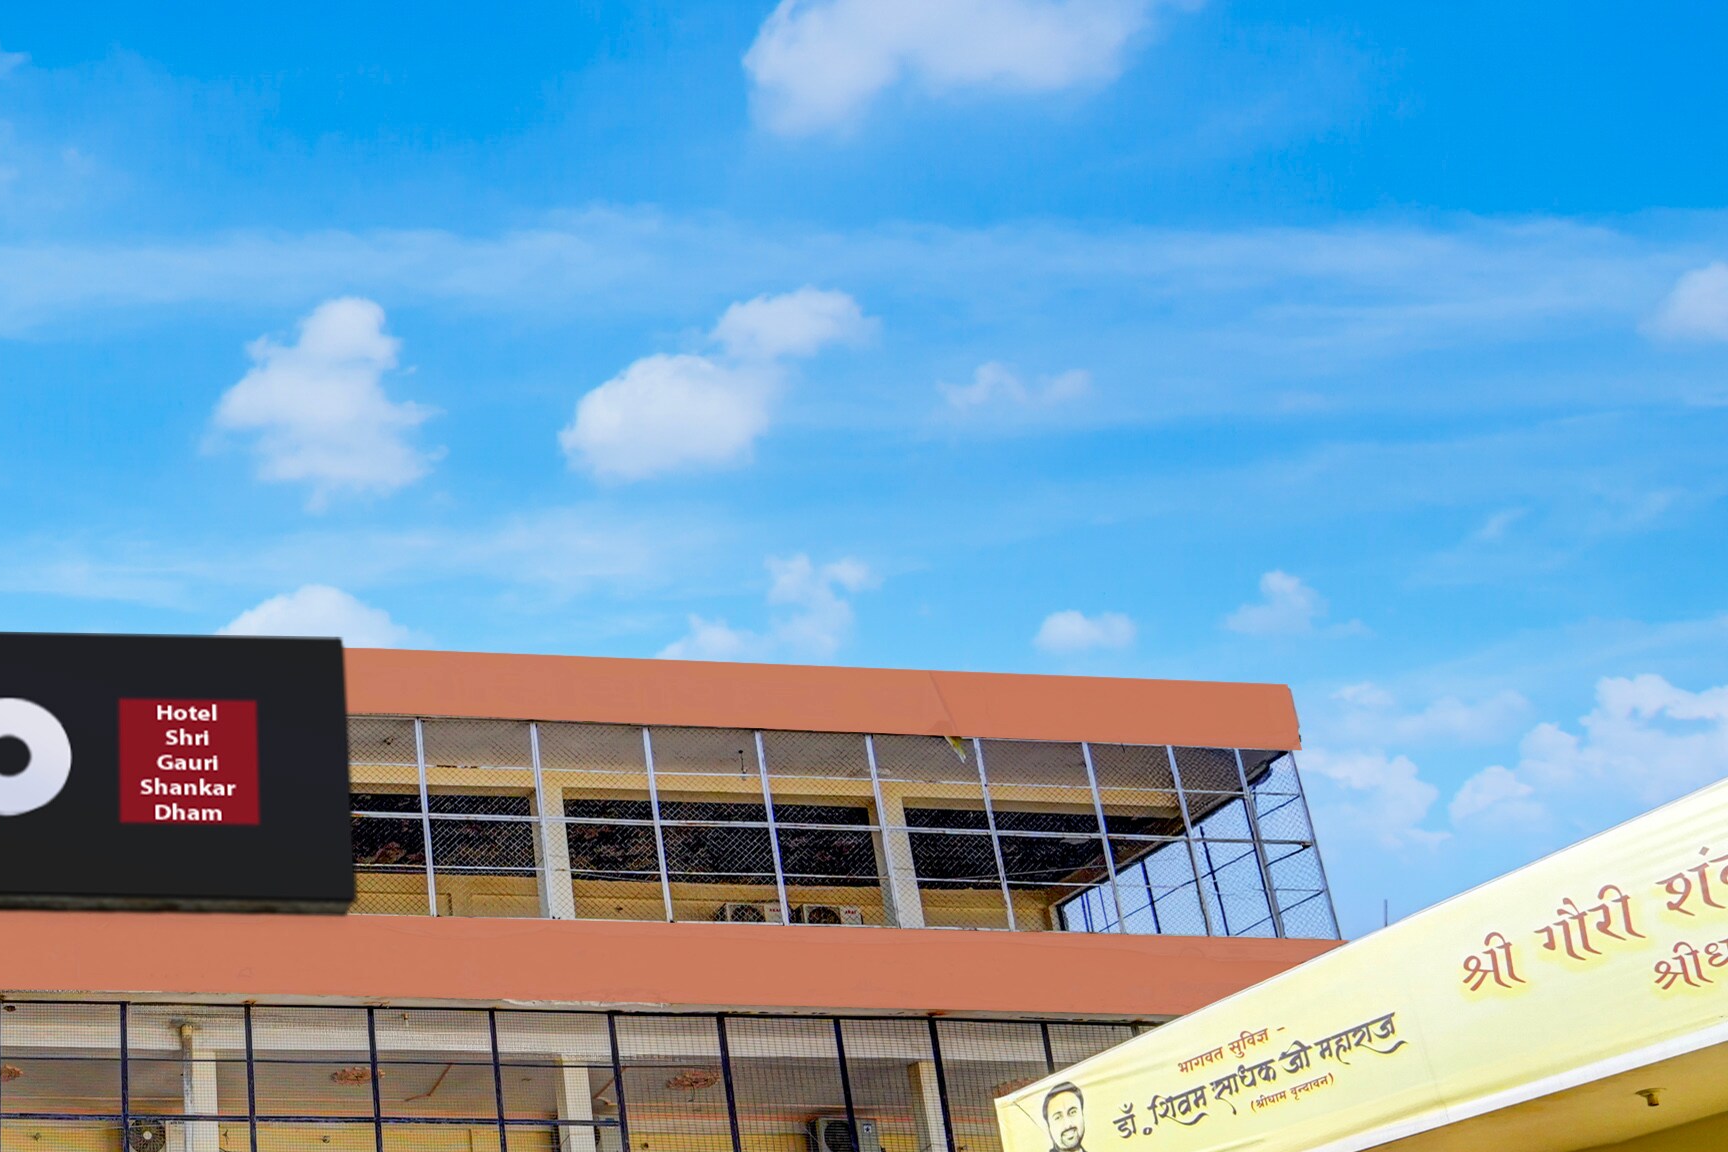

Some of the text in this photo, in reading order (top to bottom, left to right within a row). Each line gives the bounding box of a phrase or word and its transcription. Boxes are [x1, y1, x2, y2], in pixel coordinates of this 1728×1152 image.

[156, 703, 217, 721] Hotel
[165, 727, 209, 746] Shri
[156, 754, 219, 771] Gauri
[140, 777, 237, 796] Shankar
[154, 802, 223, 821] Dham
[1462, 931, 1526, 991] श्री
[1534, 884, 1647, 961] गौरी
[1177, 1027, 1270, 1074] भागवत सुविज्ञ
[1147, 1093, 1208, 1126] शिवम
[1205, 1058, 1277, 1115] साधक
[1314, 1011, 1408, 1065] महाराज
